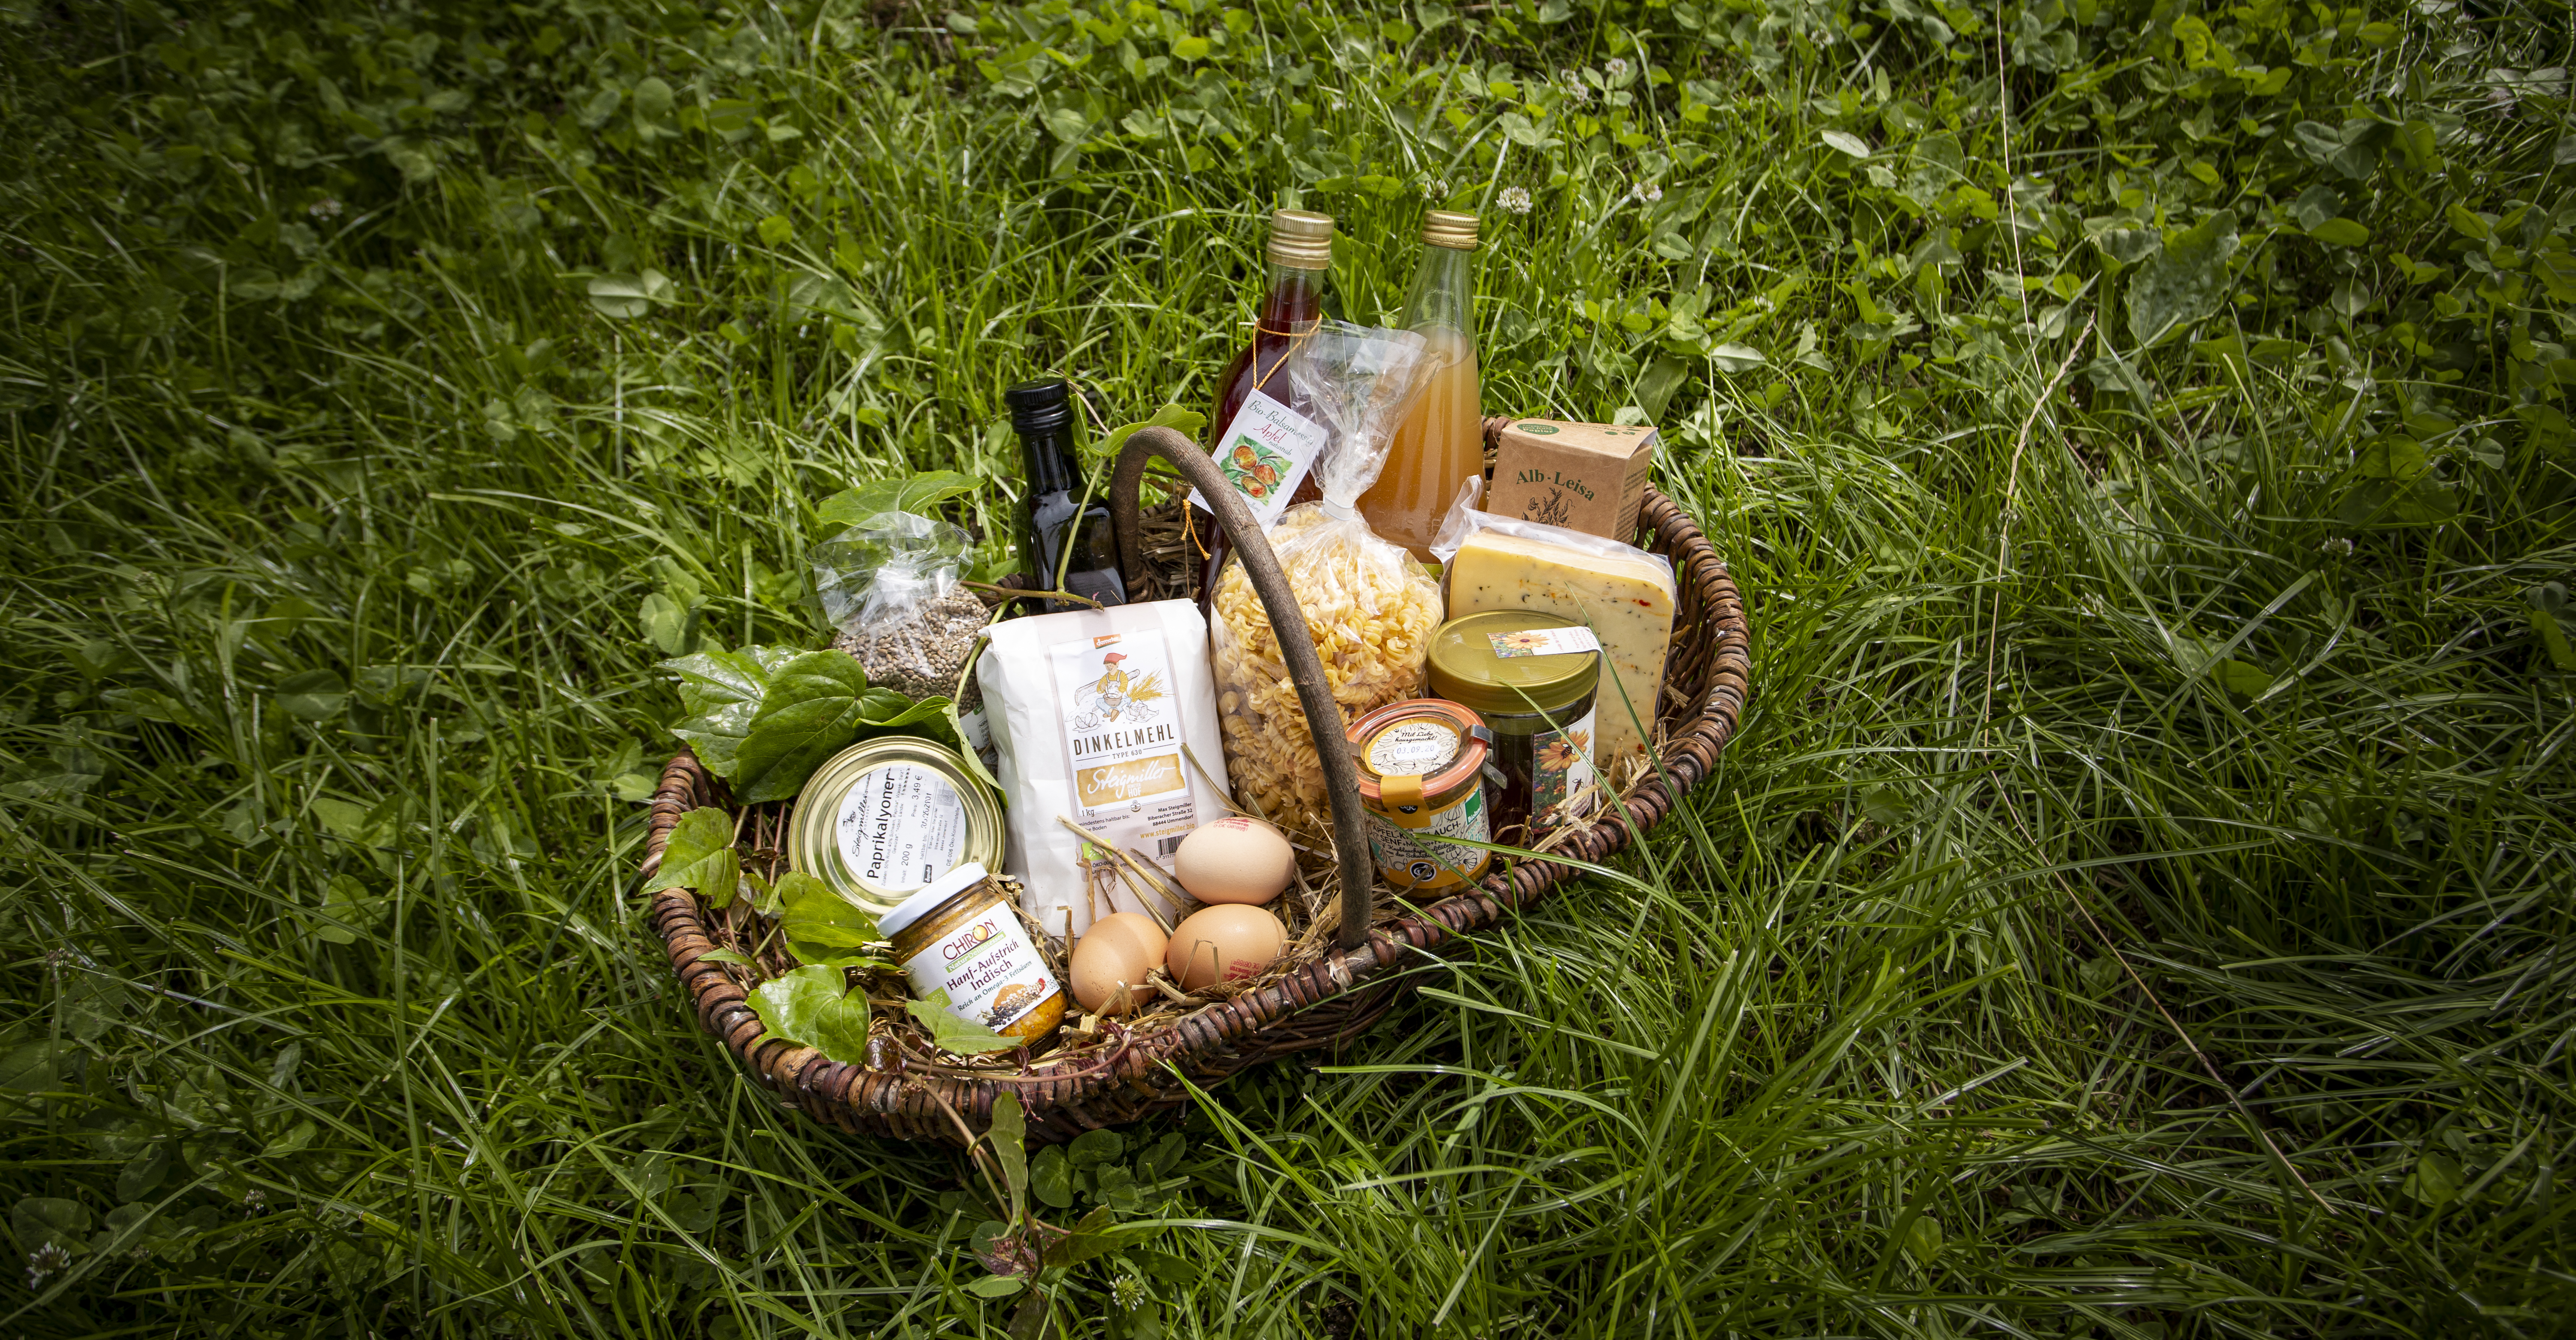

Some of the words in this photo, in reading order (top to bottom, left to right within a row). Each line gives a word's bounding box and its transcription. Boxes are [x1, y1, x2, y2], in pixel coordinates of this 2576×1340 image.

[1253, 424, 1287, 444] Apfel
[1269, 441, 1292, 455] naturtrüb
[1096, 637, 1118, 646] demeter
[1073, 724, 1174, 755] DINKELMEHL
[1397, 745, 1434, 754] 03.09.20
[1087, 760, 1176, 799] Steigmiller
[912, 783, 920, 799] 3,49
[1127, 788, 1141, 797] HOF
[1168, 802, 1191, 811] Steigmiller
[1468, 804, 1482, 823] Bioland
[852, 795, 869, 857] Steigmiller
[867, 775, 894, 878] Paprikalyoner
[949, 807, 960, 847] Öko-Kontrollstelle
[1167, 814, 1194, 823] Ummendorf
[1140, 823, 1195, 839] www.steigmiller.bio
[901, 851, 910, 866] 200
[924, 866, 932, 882] demeter
[943, 919, 998, 960] CHIRON
[948, 933, 1004, 971] NaturDelikatessen
[946, 939, 1018, 991] Hanf-Aufstrich
[970, 960, 1012, 991] Indisch
[1045, 977, 1058, 991] 135g
[957, 998, 973, 1012] Reich
[983, 976, 1008, 995] Omega-3
[1009, 961, 1032, 977] Fettsäuren
